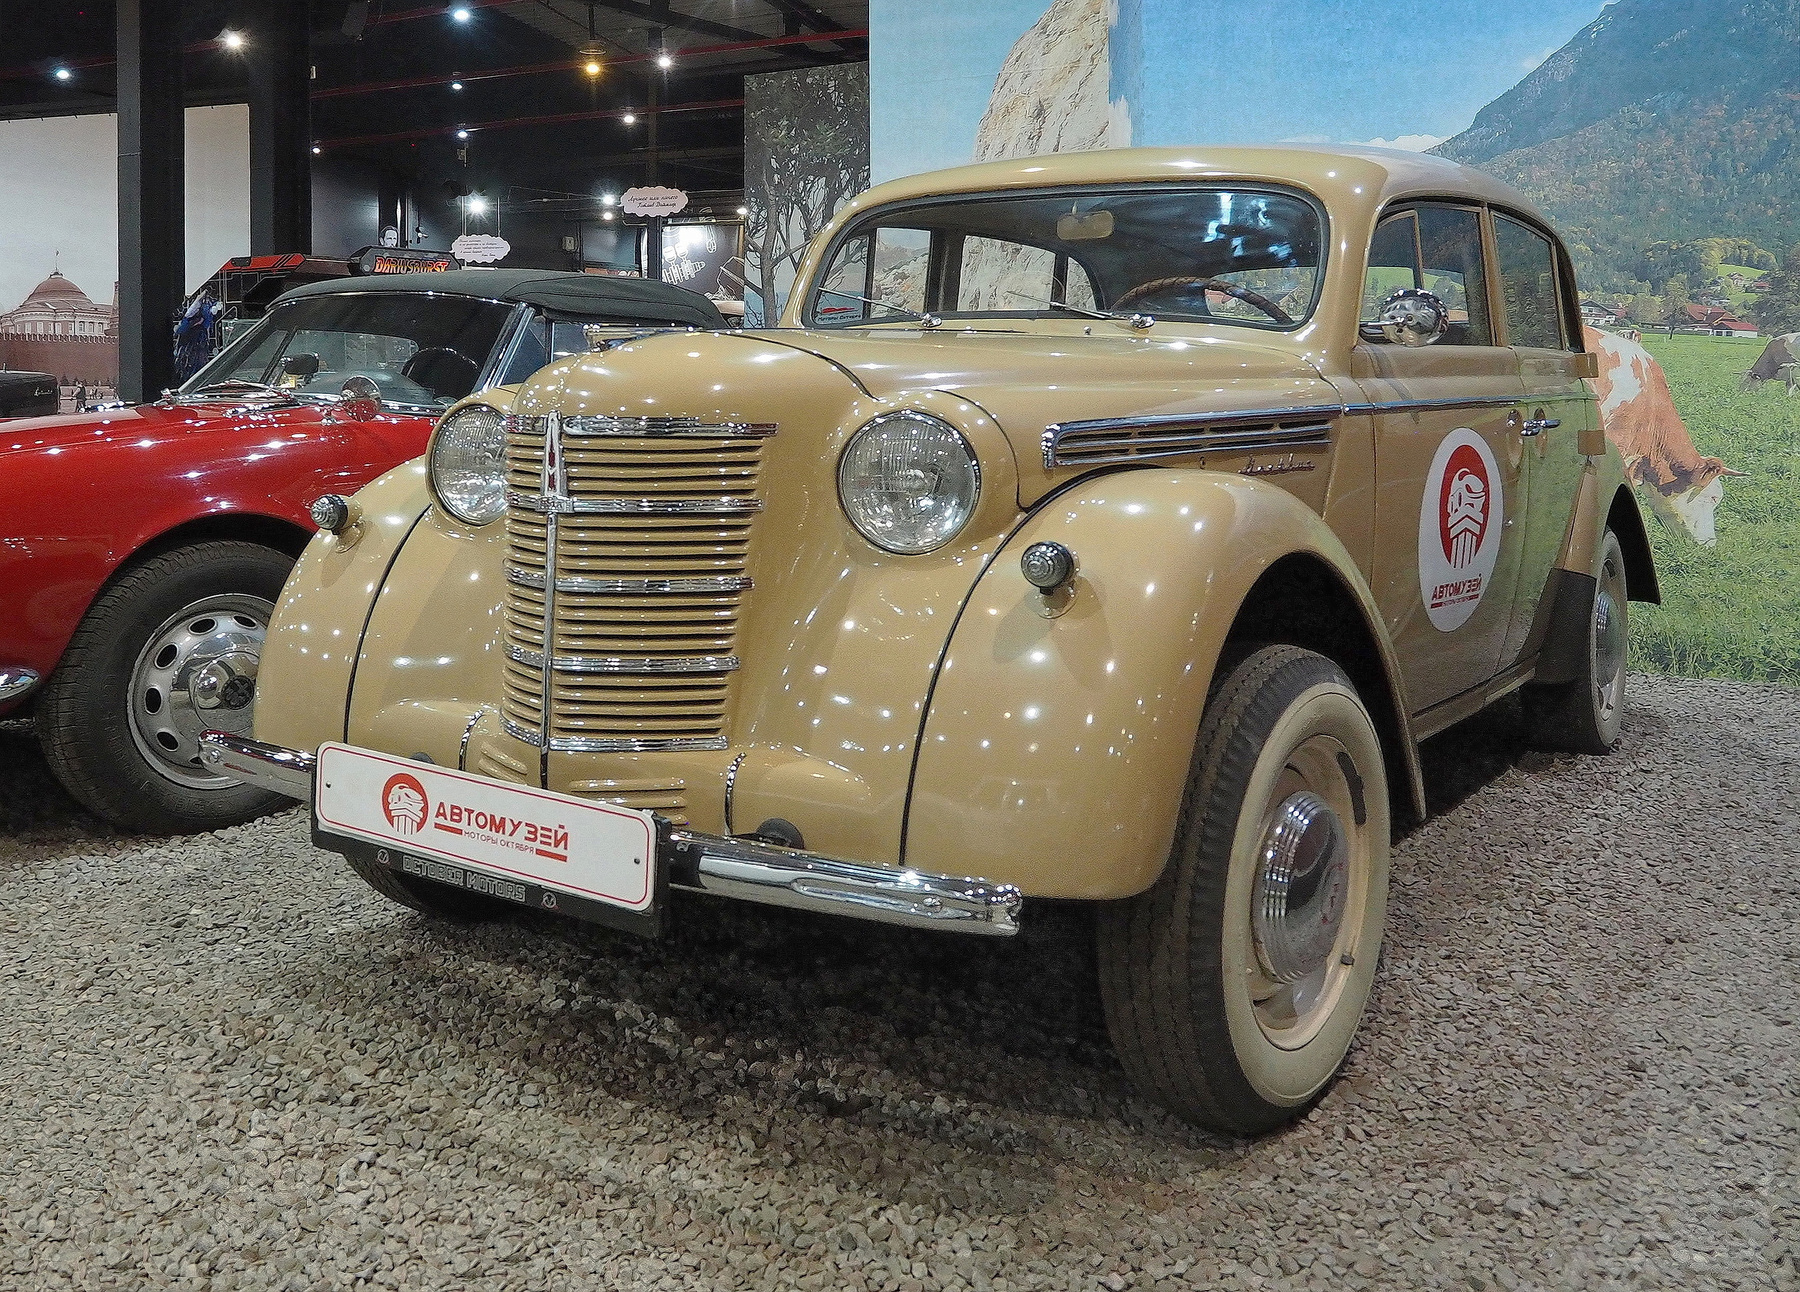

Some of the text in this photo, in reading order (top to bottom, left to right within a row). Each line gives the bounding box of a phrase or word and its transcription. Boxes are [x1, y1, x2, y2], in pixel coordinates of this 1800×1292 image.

[373, 256, 449, 274] DARIUSBURST
[1431, 573, 1482, 601] АВТОМУЗЕЙ
[434, 801, 569, 850] АВТОМУЗЕЙ
[463, 830, 535, 854] МОТОРЫ ОКТЯБРЯ
[402, 854, 526, 902] OCTOBER MOTORS
